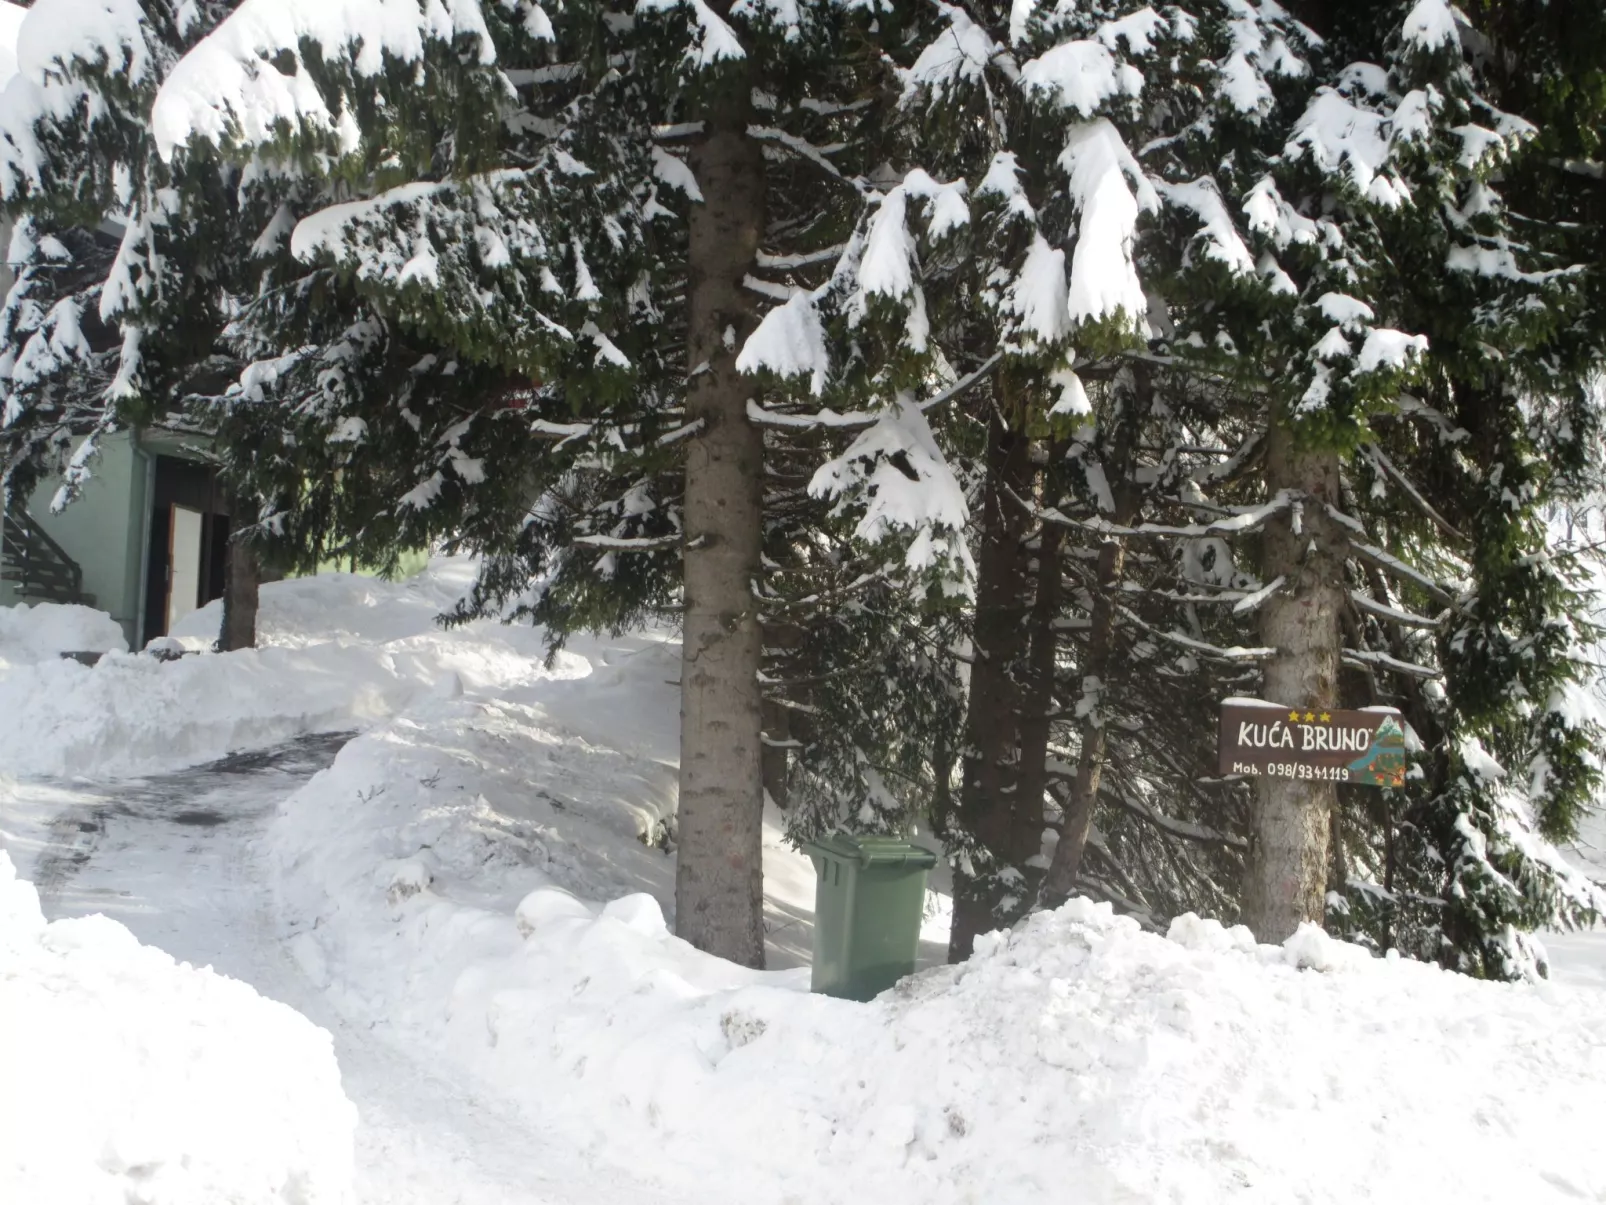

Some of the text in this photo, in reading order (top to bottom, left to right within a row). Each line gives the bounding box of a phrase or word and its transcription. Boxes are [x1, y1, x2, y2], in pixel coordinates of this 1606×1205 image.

[1237, 721, 1294, 748] KUĆA
[1233, 762, 1349, 781] Mob. 098/9341119
